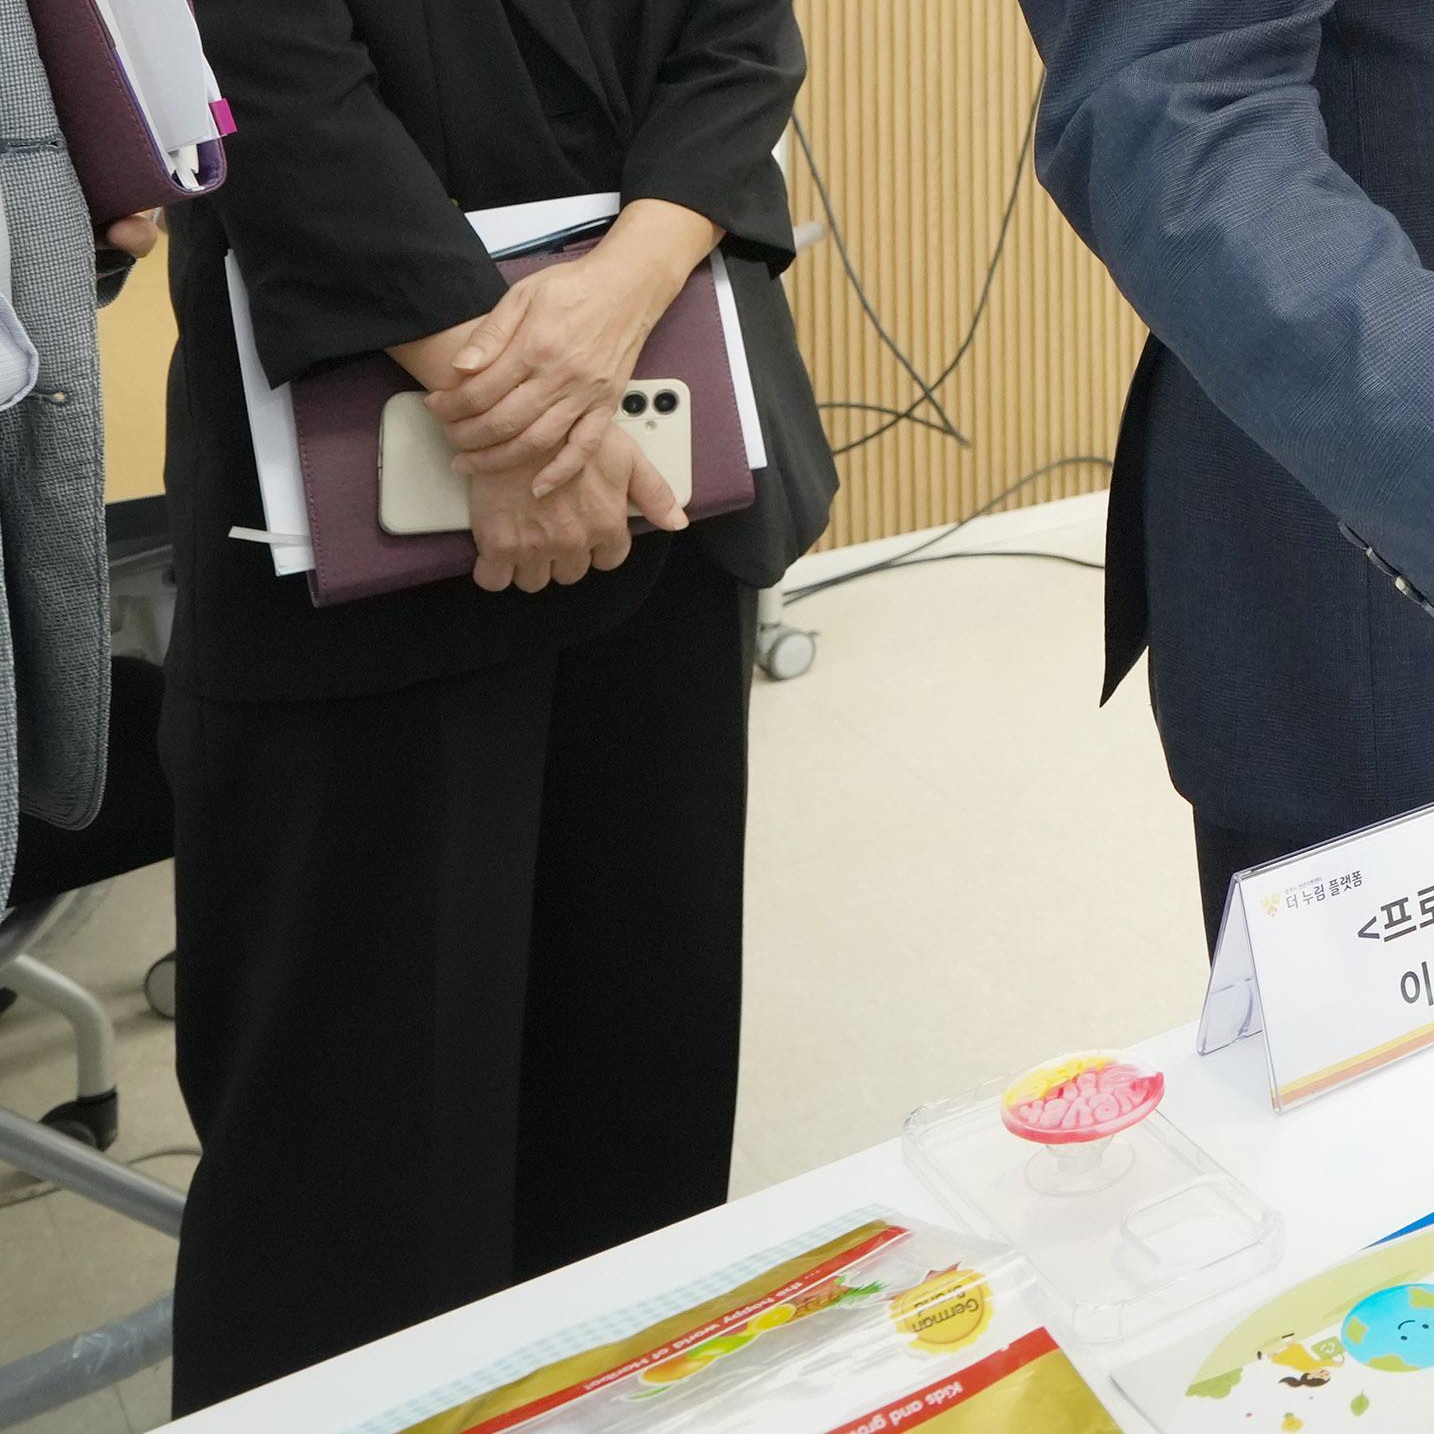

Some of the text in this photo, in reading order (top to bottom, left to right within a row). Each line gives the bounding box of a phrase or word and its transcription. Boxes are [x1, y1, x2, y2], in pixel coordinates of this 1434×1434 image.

[1286, 894, 1299, 909] 더
[1302, 884, 1326, 905] 누림
[1329, 870, 1362, 897] 플랫폼
[724, 1297, 775, 1324] happy
[912, 1298, 979, 1332] German
[672, 1324, 720, 1349] world
[651, 1348, 670, 1360] of
[925, 1381, 964, 1405] Kids
[888, 1400, 923, 1426] and
